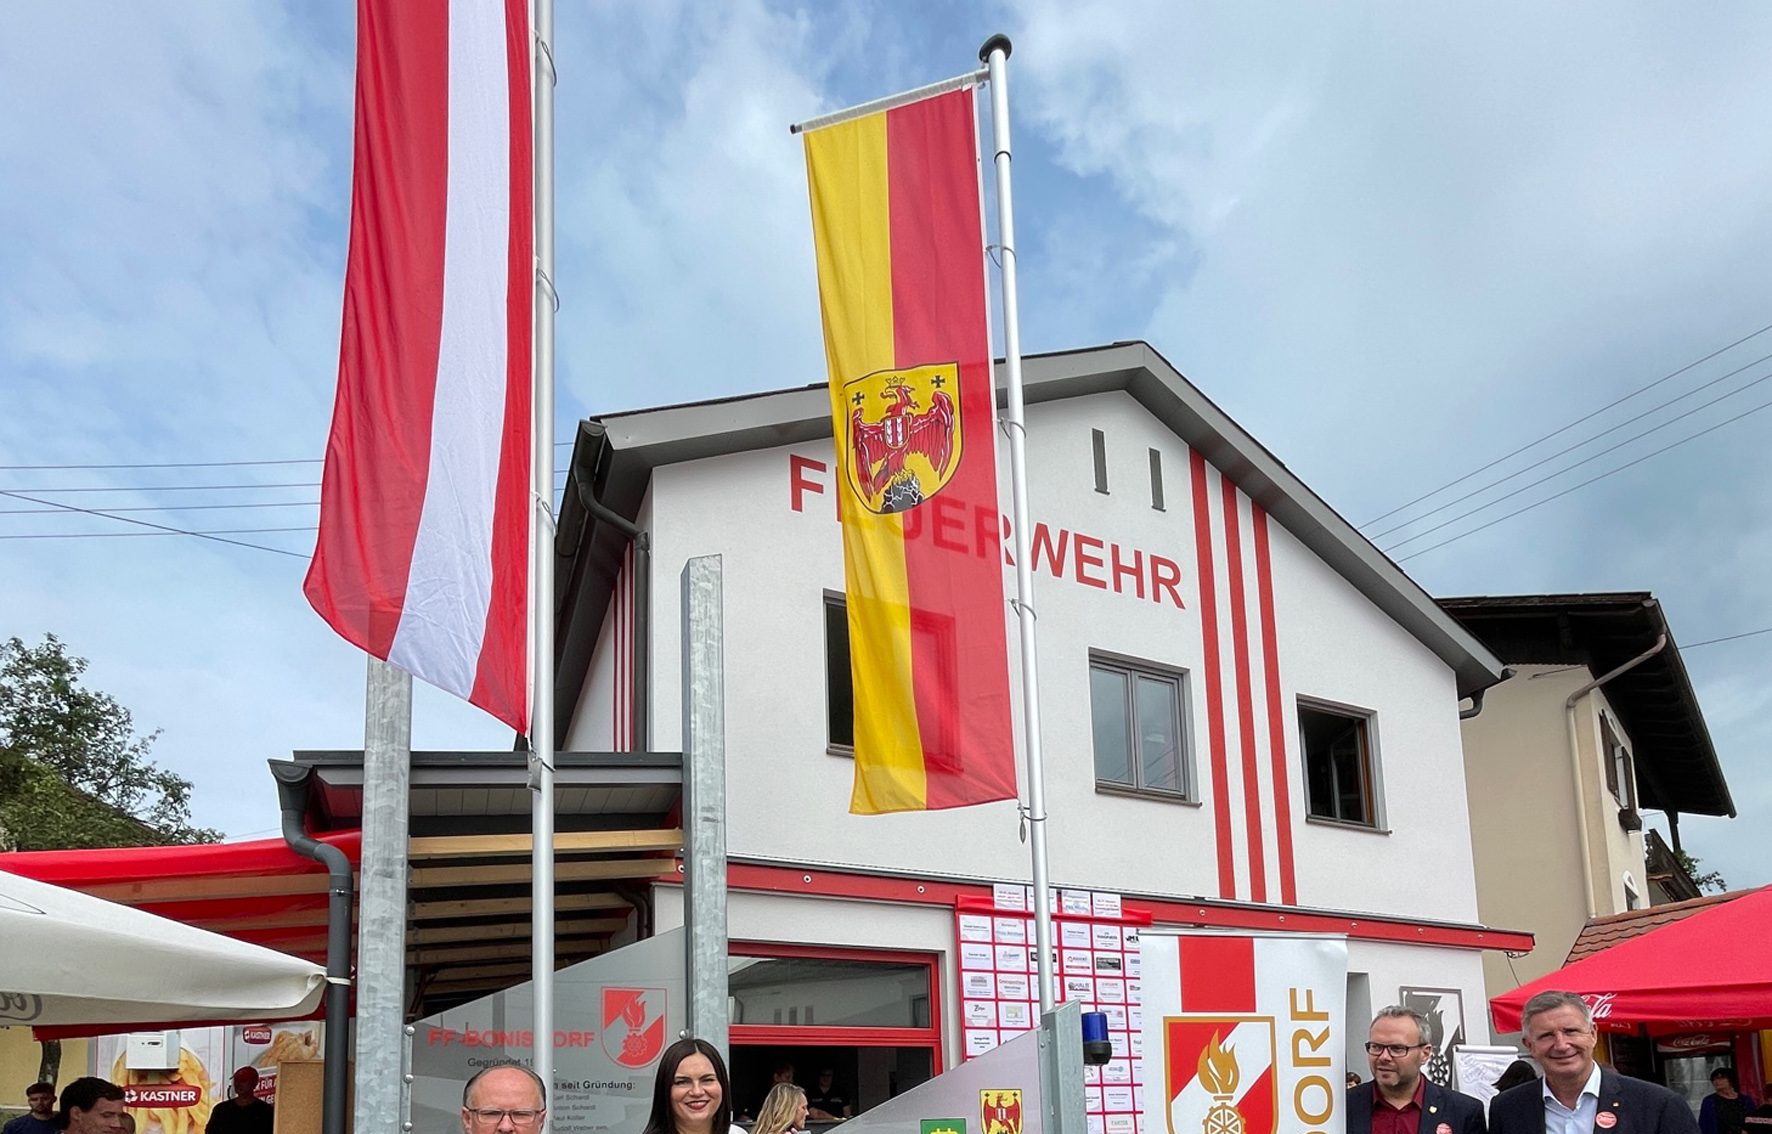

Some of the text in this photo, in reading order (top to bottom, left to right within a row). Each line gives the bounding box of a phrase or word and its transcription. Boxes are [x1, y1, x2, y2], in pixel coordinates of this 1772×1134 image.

[428, 1029, 595, 1048] FF-BONISORF
[561, 1082, 580, 1090] seit
[583, 1080, 636, 1090] Gründung:
[140, 1090, 196, 1102] KASTNER
